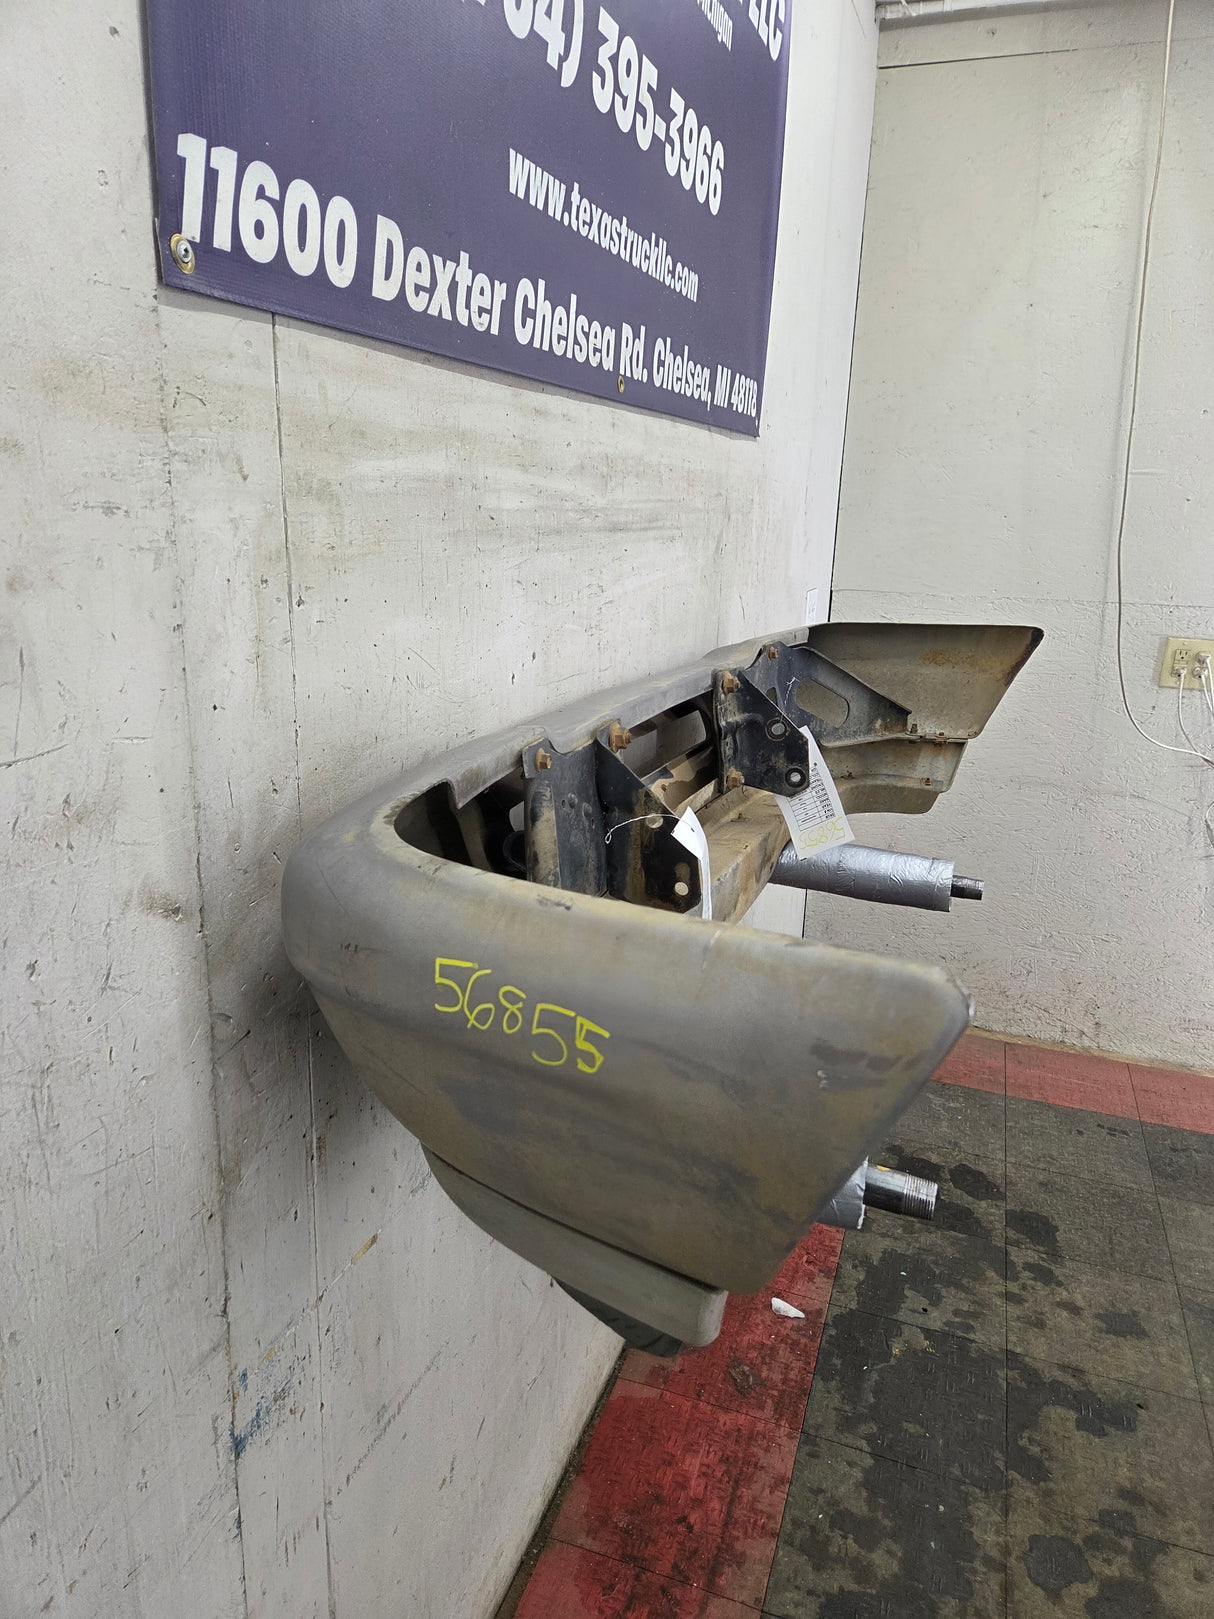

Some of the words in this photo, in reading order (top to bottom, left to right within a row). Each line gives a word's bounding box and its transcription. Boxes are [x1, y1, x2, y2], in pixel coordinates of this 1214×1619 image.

[592, 6, 724, 216] 395-3966
[177, 132, 358, 288] 11600
[372, 214, 507, 336] Dexter
[514, 277, 615, 372] Chelsea
[619, 322, 648, 383] Rd.
[652, 337, 711, 412] Chelsea,
[713, 364, 732, 408] MI
[730, 372, 758, 418] 48118
[509, 147, 699, 302] www.texastruckllc.com
[435, 957, 610, 1073] 56855
